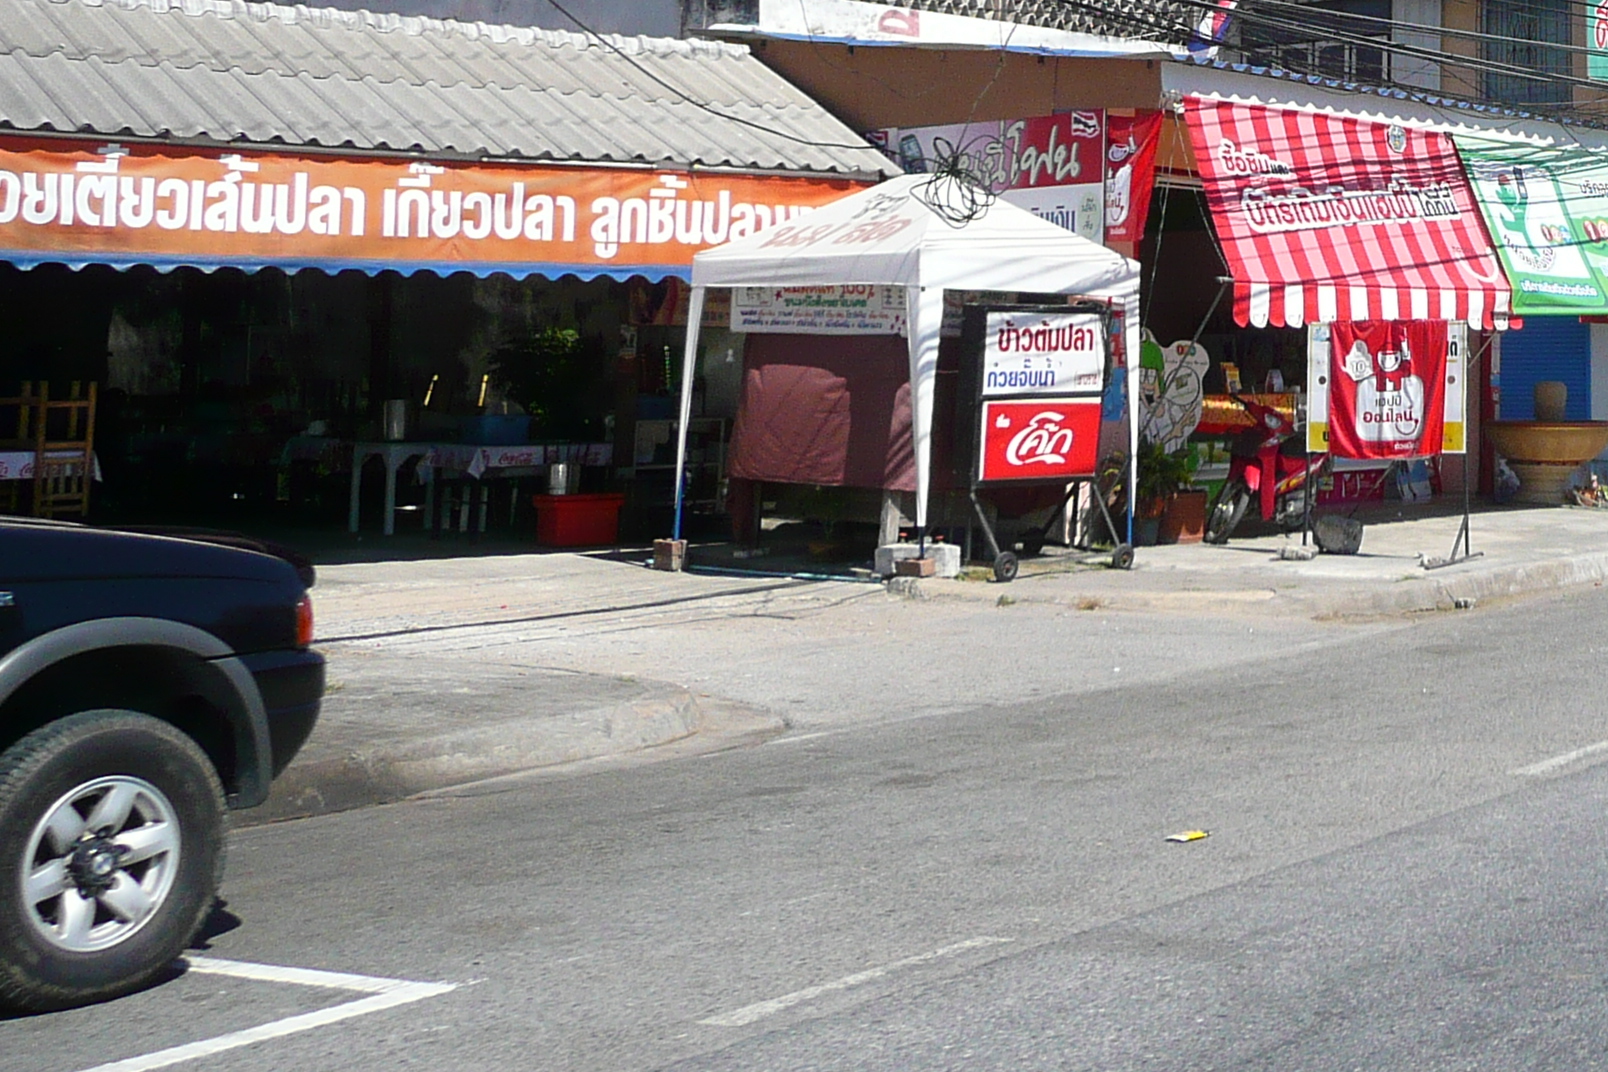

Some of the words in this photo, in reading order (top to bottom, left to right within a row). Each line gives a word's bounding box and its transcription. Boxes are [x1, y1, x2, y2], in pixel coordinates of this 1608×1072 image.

[382, 161, 576, 240] เกี๊ยวปลา
[997, 320, 1094, 352] ข้าวต้มปลา
